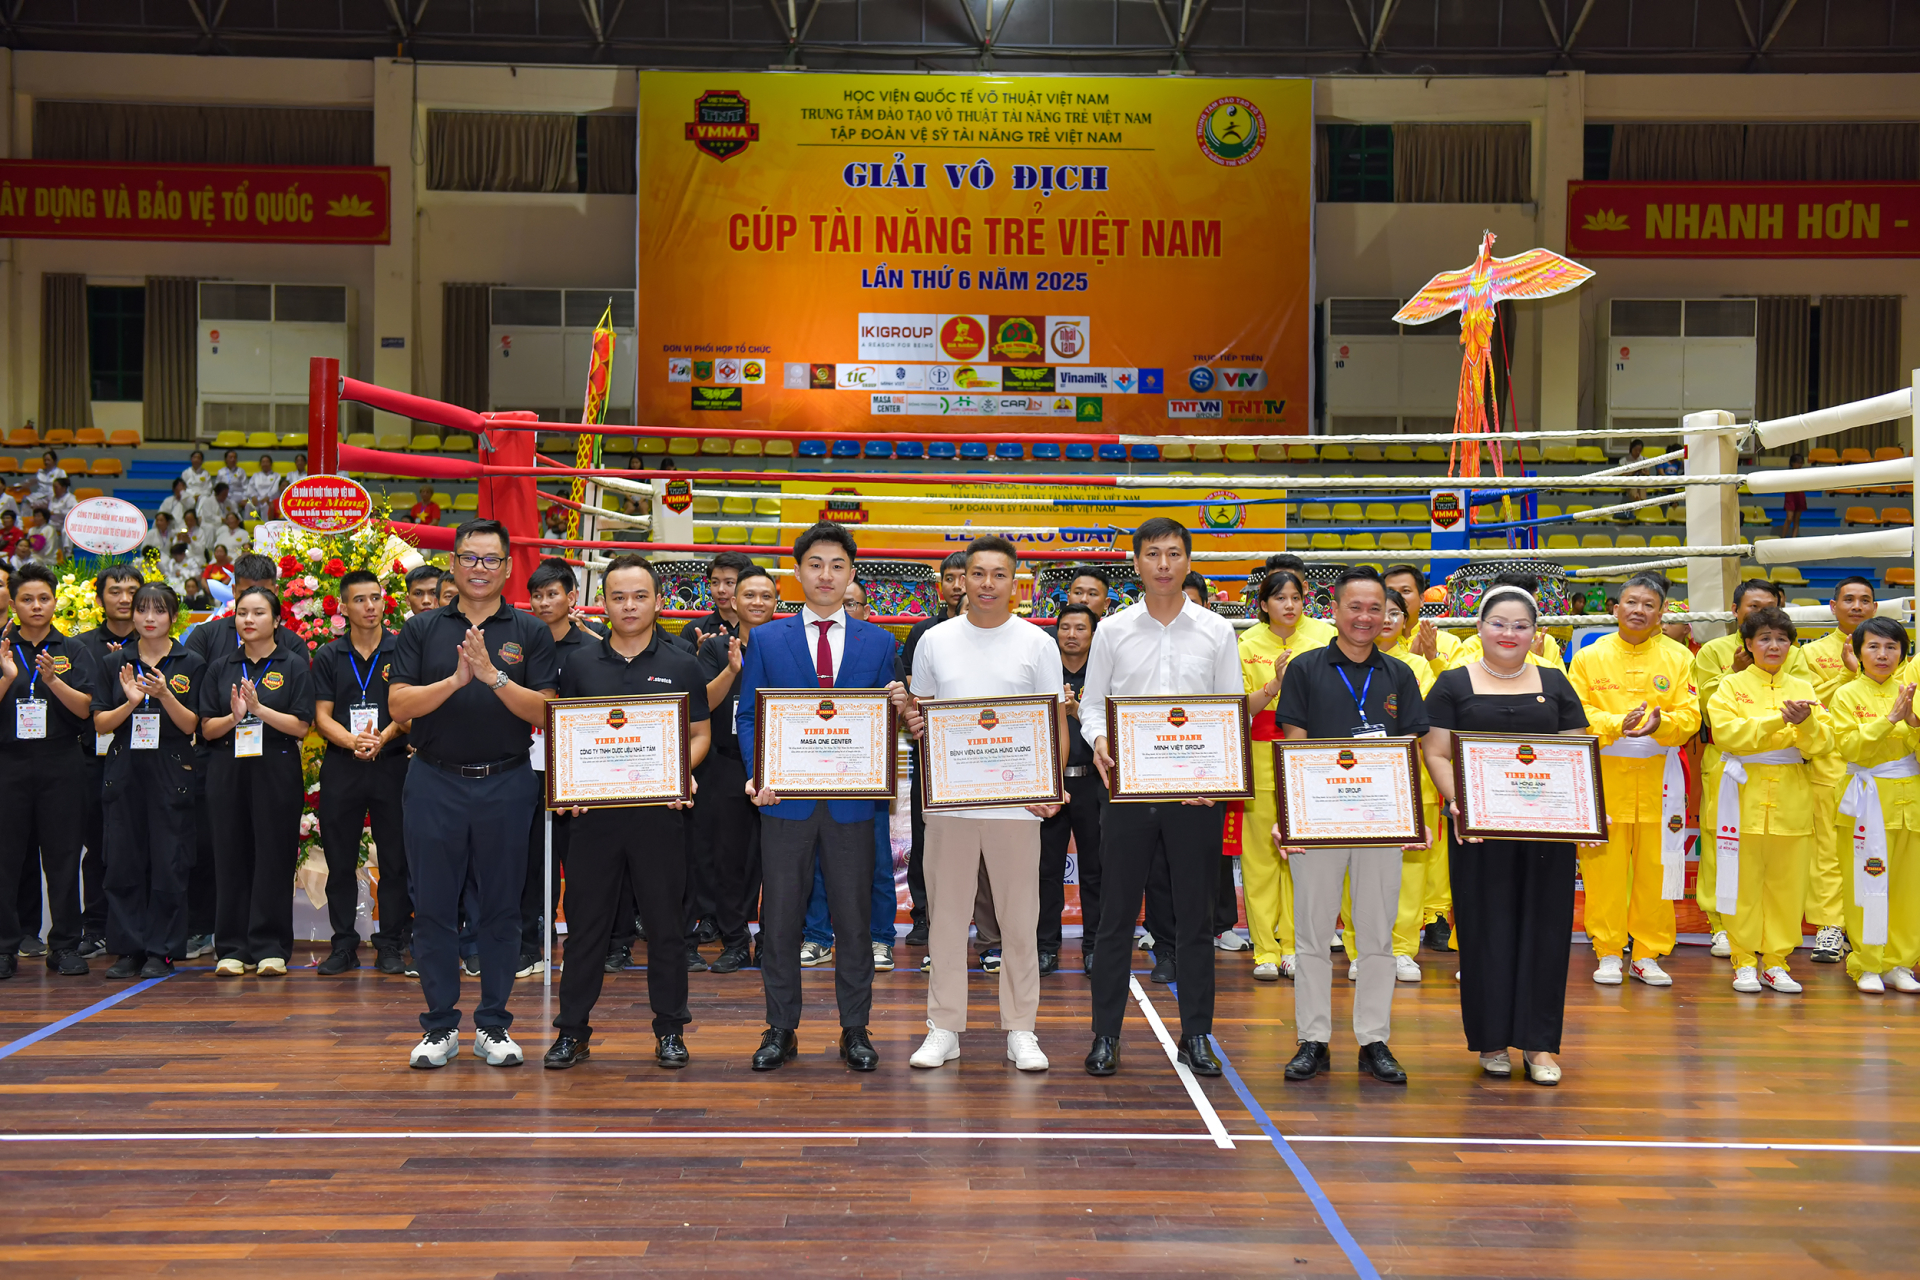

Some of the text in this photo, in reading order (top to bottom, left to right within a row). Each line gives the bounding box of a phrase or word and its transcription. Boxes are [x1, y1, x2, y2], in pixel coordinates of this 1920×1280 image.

[843, 88, 1110, 107] HỌC VIỆN QUỐC TẾ VÕ THUẬT VIỆT NAM
[801, 108, 844, 121] TRUNG
[906, 109, 933, 124] TẠO
[956, 109, 998, 125] THUẬT
[1001, 109, 1023, 123] TÀI
[1025, 109, 1062, 124] NĂNG
[1064, 107, 1089, 124] TRẺ
[1091, 110, 1121, 127] VIỆT
[1124, 112, 1152, 125] NAM
[696, 126, 748, 138] VMMA
[830, 126, 1122, 145] TẬP ĐOÀN VỆ SỸ TÀI NĂNG TRẺ VIỆT NAM
[844, 152, 1109, 197] GIẢI VÔ ĐỊCH
[0, 180, 314, 227] ÂY DỰNG VÀ BẢO VỆ TỔ QUỐC
[1645, 199, 1881, 240] NHANH HƠN
[728, 201, 1222, 266] CÚP TÀI NĂNG TRẺ VIỆT NAM
[861, 262, 1089, 292] LẦN THỨ 6 NĂM 2025
[684, 345, 692, 354] VỊ
[694, 342, 714, 353] PHỐI
[716, 345, 733, 355] HỢP
[748, 344, 772, 354] CHỨC
[1193, 353, 1263, 363] TRỰC TIẾP TRÊN
[1060, 371, 1108, 384] Vinamilk
[1223, 372, 1259, 387] VTV
[873, 396, 905, 404] MASA ONE
[877, 405, 901, 413] CENTER
[348, 487, 357, 498] NAM
[287, 498, 366, 509] Chúc Mừng
[667, 495, 690, 503] VMMA
[826, 511, 862, 520] VMMA
[1434, 510, 1459, 518] VMMA
[594, 736, 642, 745] VINH DANH
[967, 736, 1013, 745] VINH DANH
[949, 749, 964, 757] BỆNH
[964, 748, 976, 756] VIỆN
[984, 747, 999, 755] KHOA
[999, 746, 1014, 754] HÙNG
[1014, 745, 1032, 753] VƯƠNG
[1325, 776, 1373, 785] VINH DANH
[1528, 772, 1551, 780] DANH
